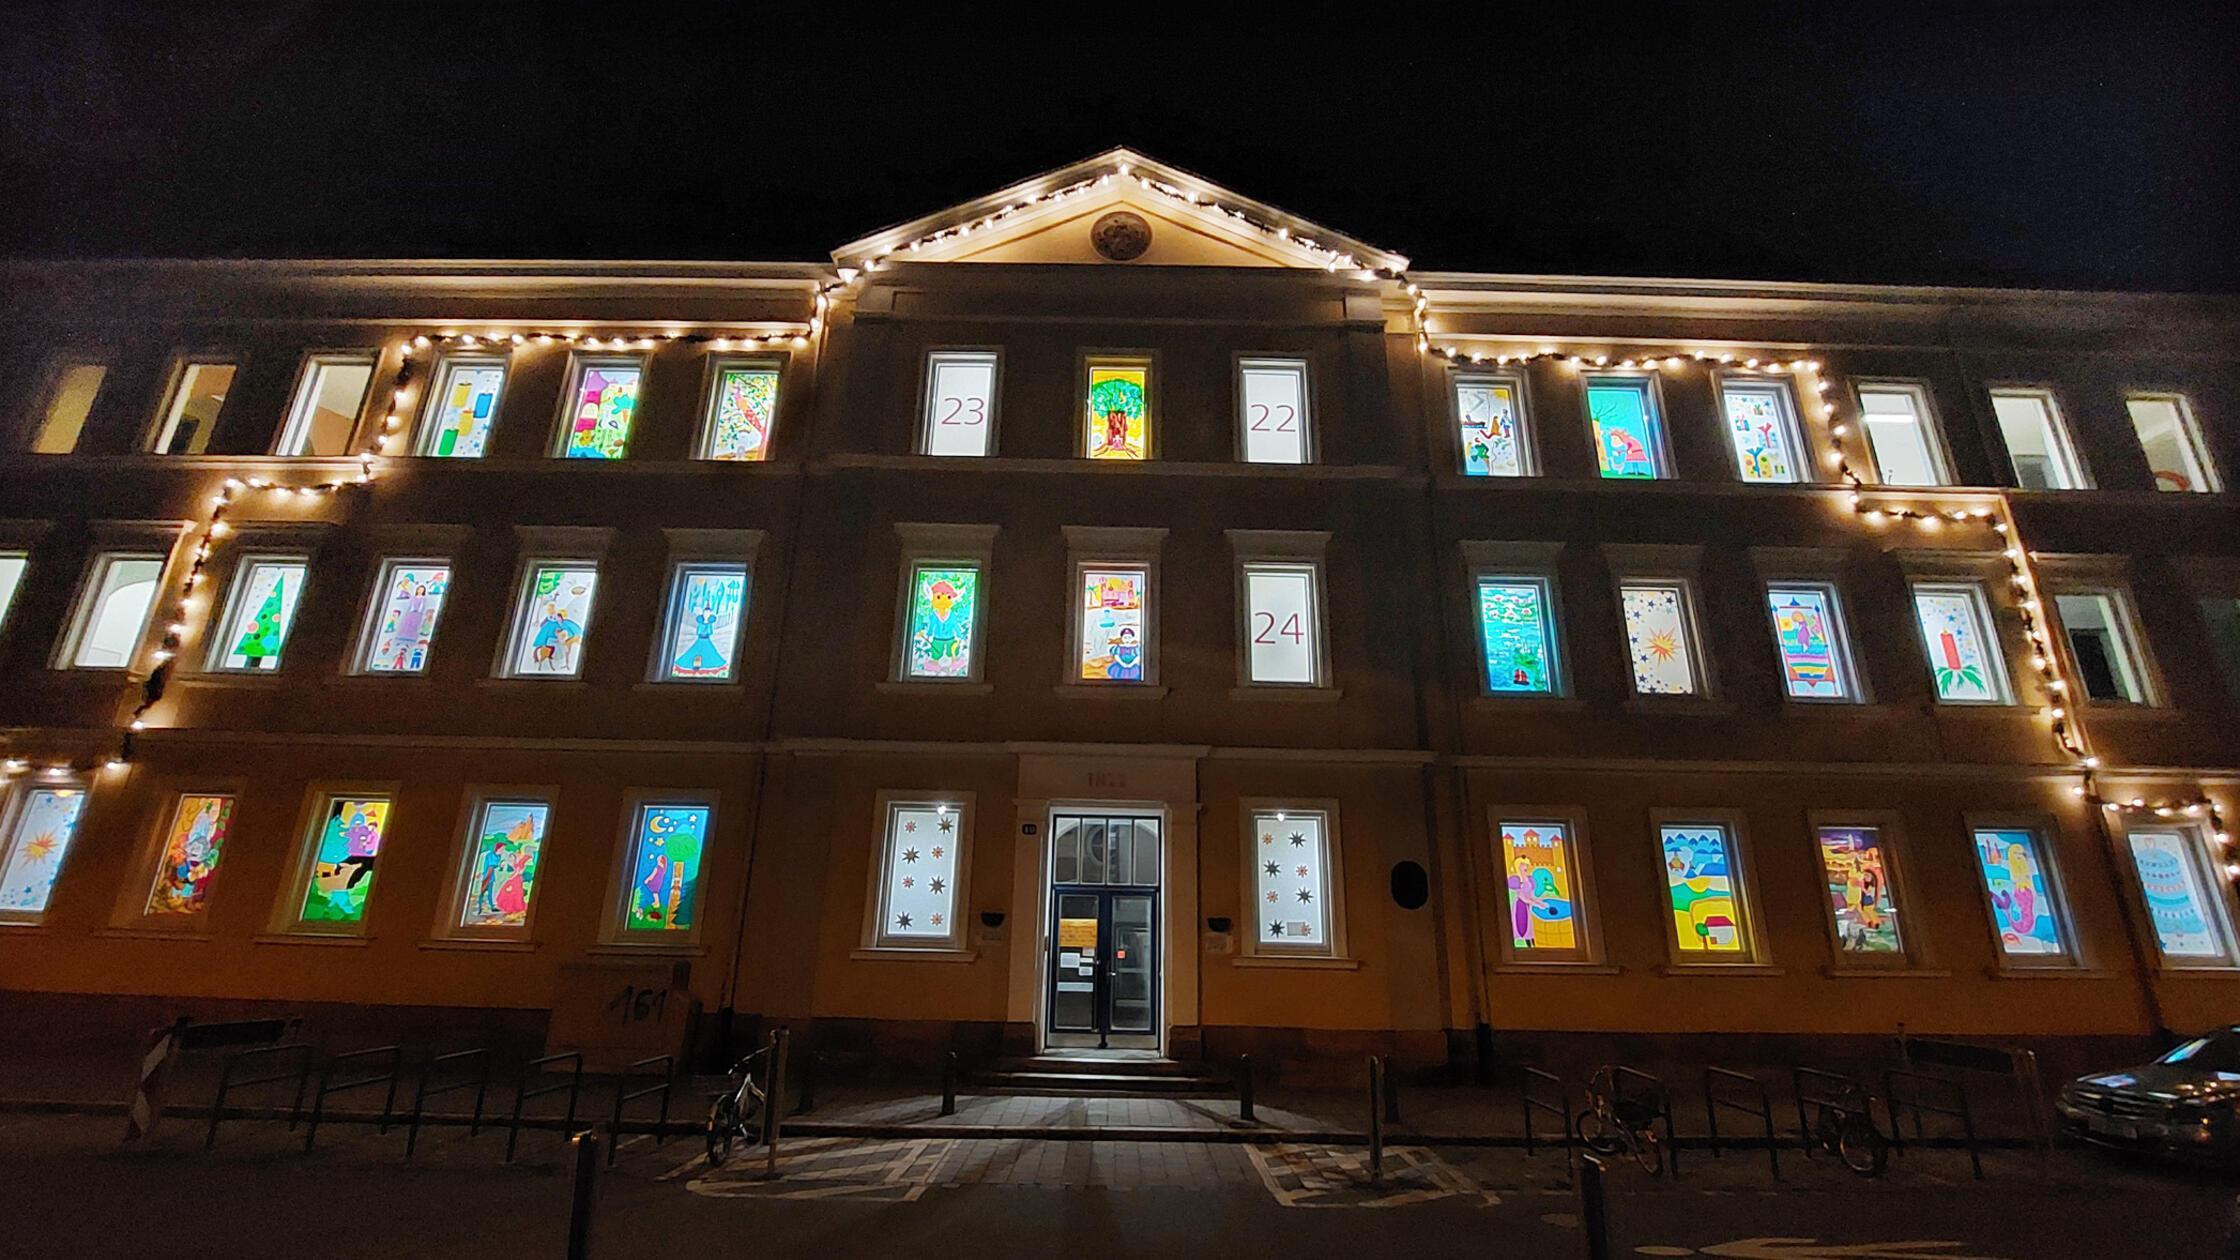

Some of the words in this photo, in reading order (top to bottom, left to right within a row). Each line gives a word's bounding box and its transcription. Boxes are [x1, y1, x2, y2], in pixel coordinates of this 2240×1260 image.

[941, 397, 984, 425] 23
[1251, 404, 1296, 432] 22
[1254, 611, 1304, 645] 24
